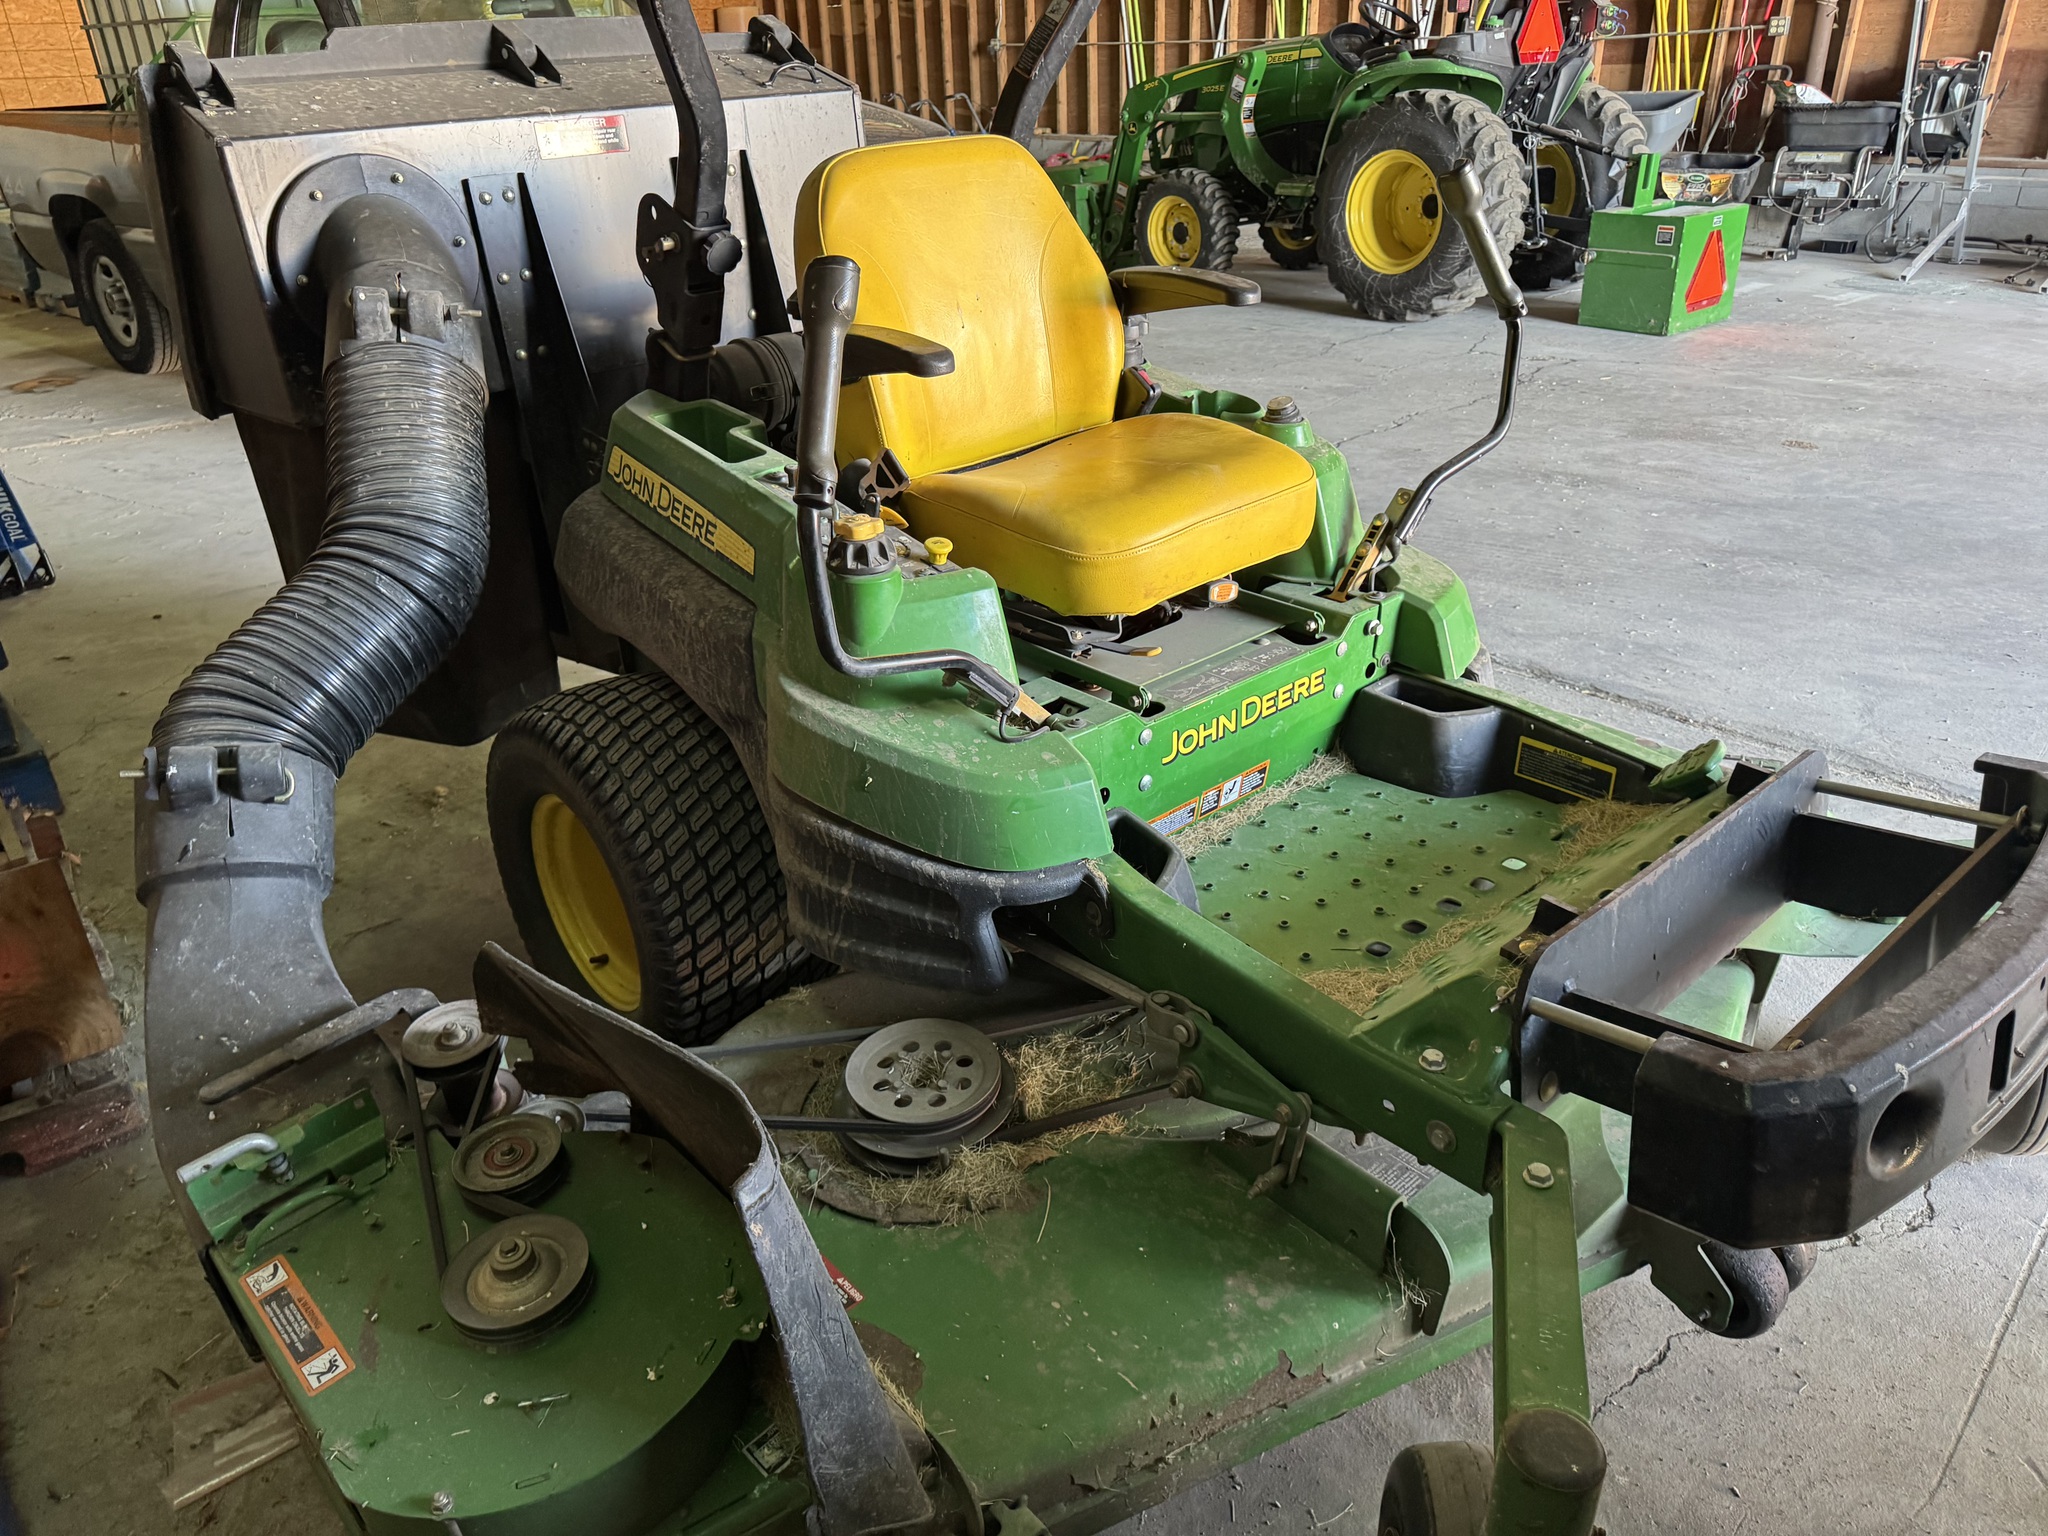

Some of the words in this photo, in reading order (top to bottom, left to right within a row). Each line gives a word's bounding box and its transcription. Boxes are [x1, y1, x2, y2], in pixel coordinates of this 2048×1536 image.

[1267, 53, 1294, 64] DEERE
[1202, 85, 1225, 94] 3025E
[613, 455, 654, 505] JOHN
[657, 482, 717, 547] DEERE
[1161, 708, 1238, 766] JOHN
[1241, 667, 1326, 728] DEERE
[840, 1279, 864, 1302] PELIGRO
[300, 1299, 321, 1330] WARNING
